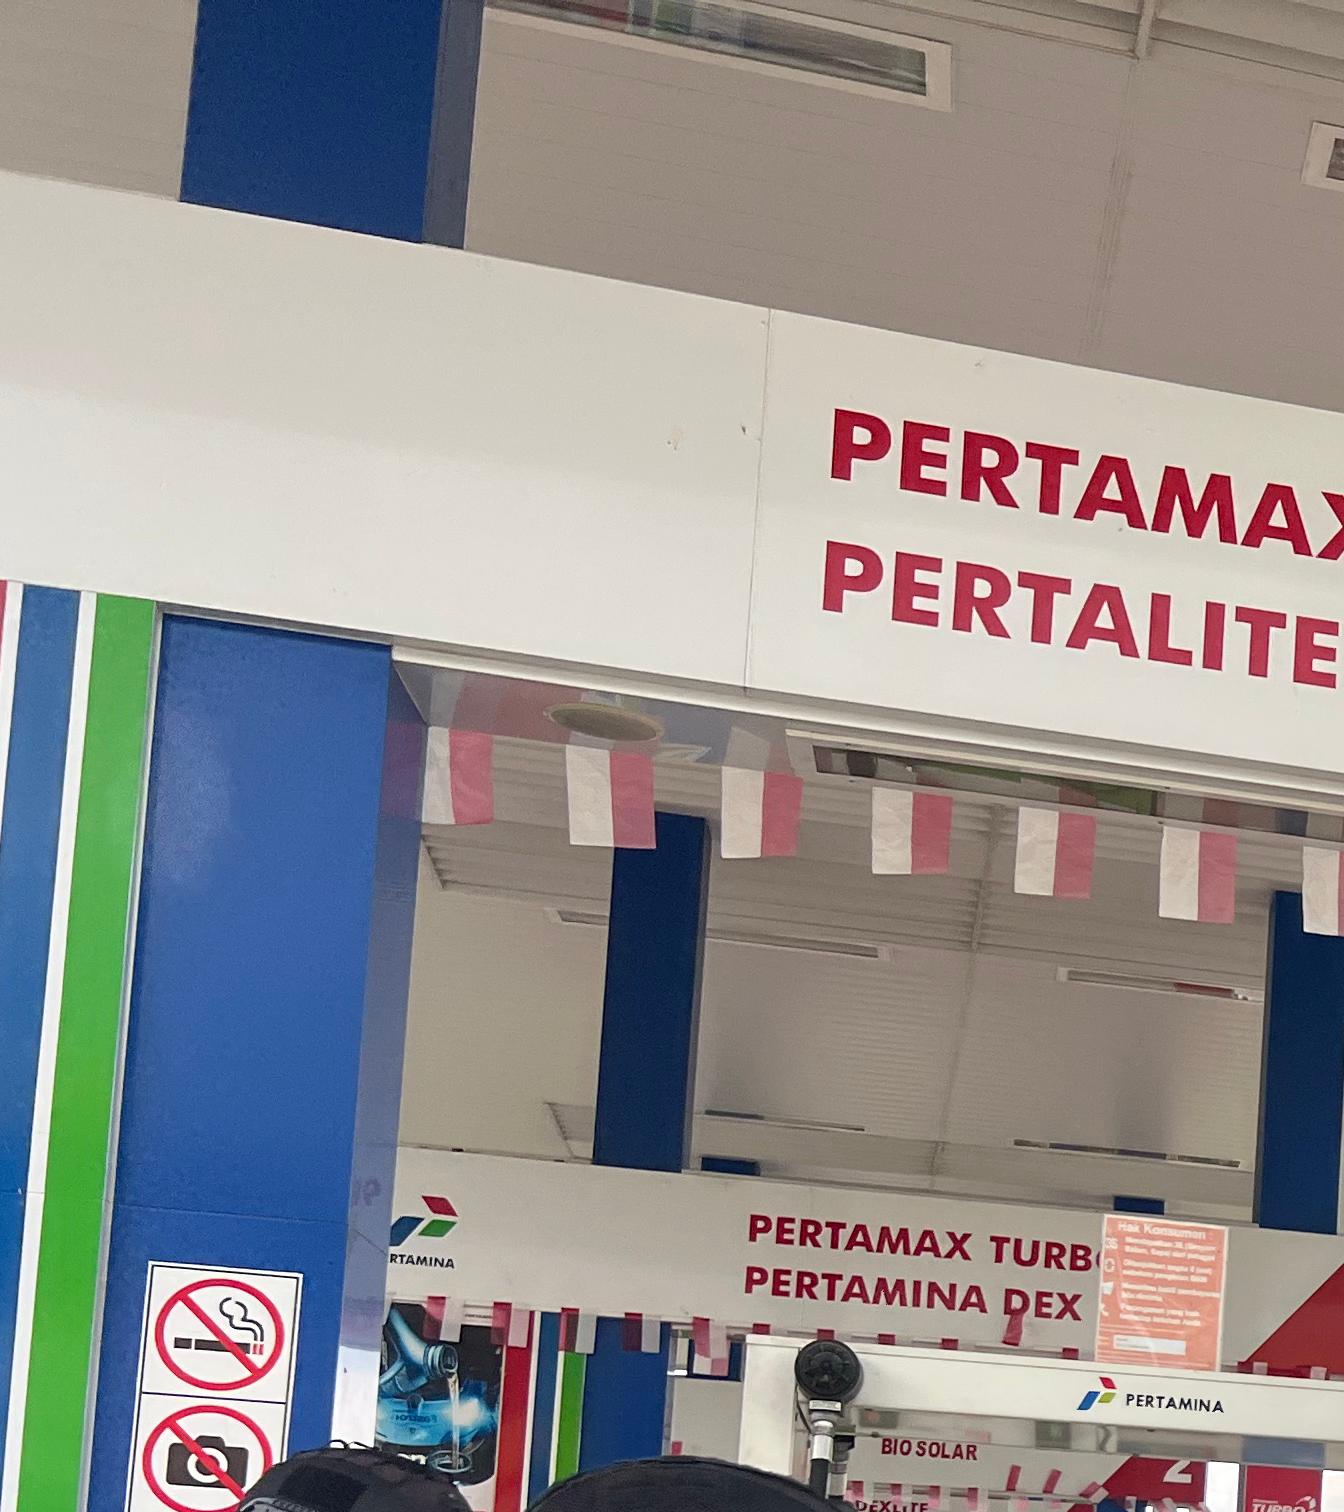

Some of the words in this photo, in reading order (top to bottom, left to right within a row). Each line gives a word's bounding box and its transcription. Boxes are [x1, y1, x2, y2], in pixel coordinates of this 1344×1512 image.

[821, 540, 1340, 689] PERTALITE
[748, 1214, 973, 1262] PERTAMAX
[990, 1236, 1100, 1273] TURB
[1143, 1223, 1206, 1240] Konsumen
[389, 1253, 455, 1269] RTAMINA
[744, 1267, 988, 1315] PERTAMINA
[1004, 1289, 1083, 1322] DEX
[1125, 1393, 1225, 1414] PERTAMINA
[881, 1437, 912, 1456] BIO
[916, 1440, 978, 1461] SOLAR
